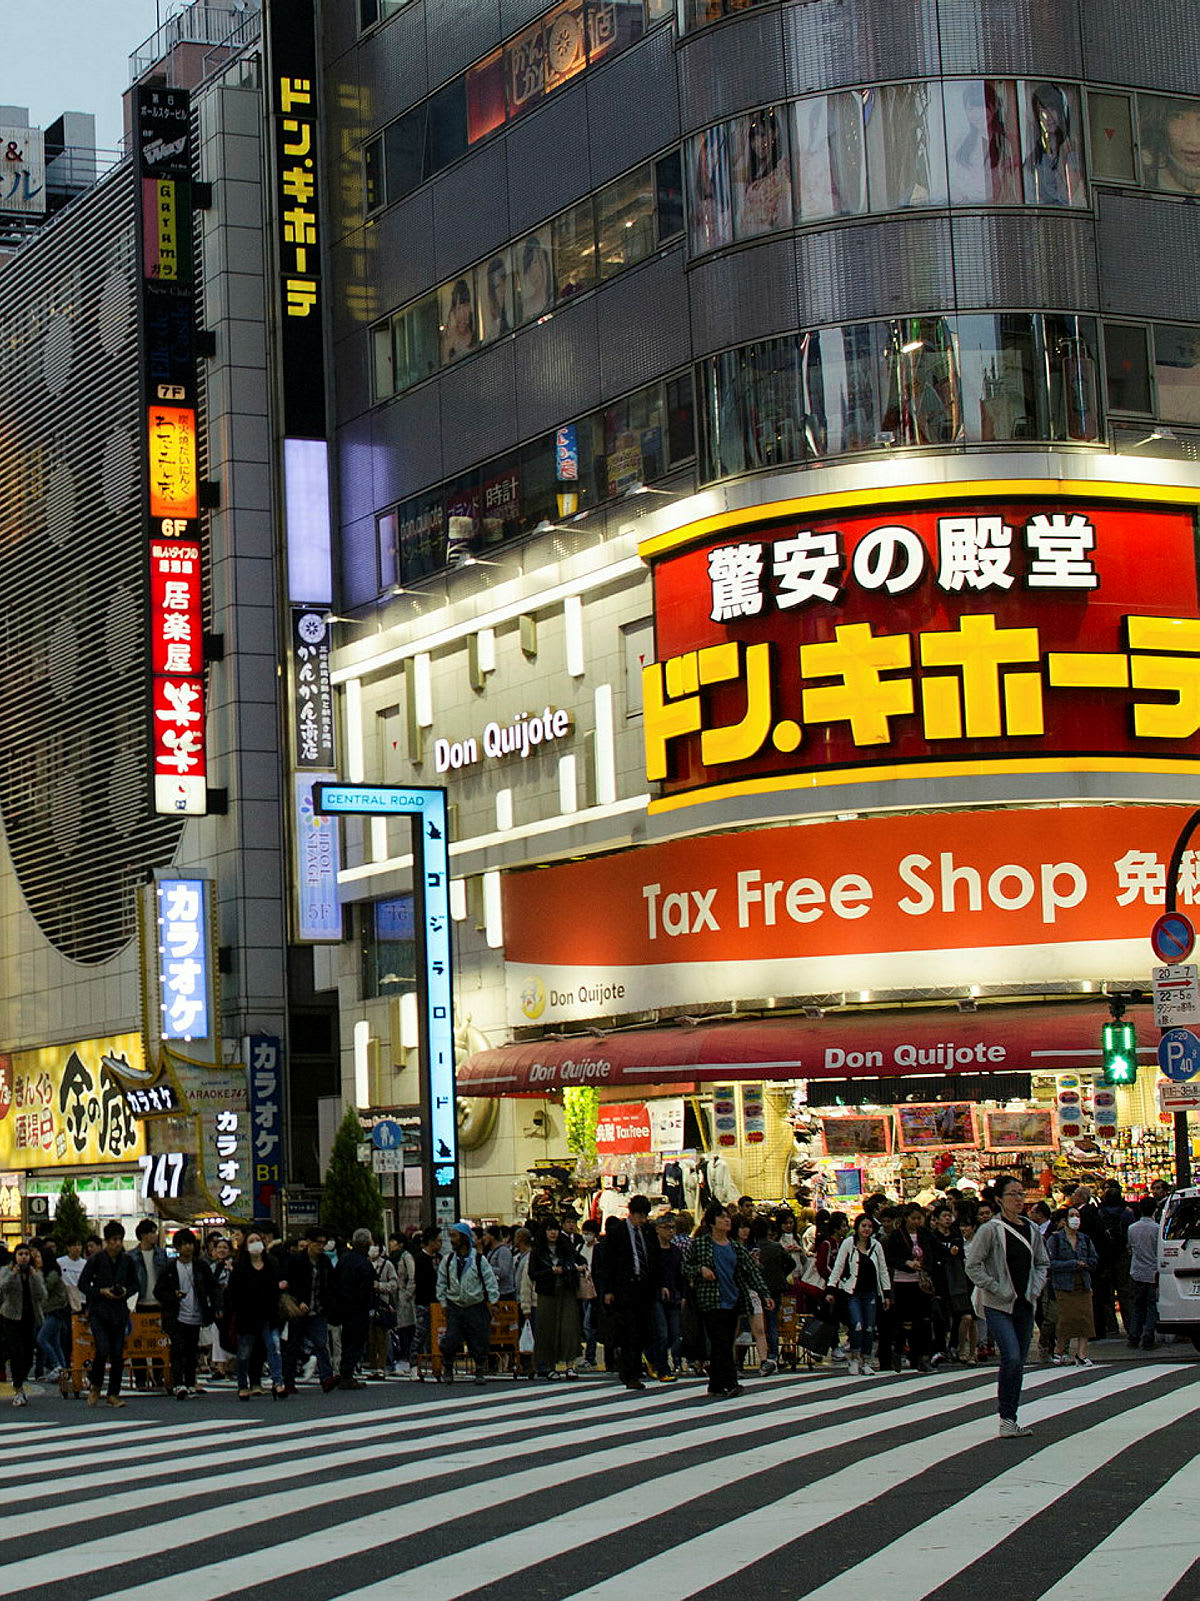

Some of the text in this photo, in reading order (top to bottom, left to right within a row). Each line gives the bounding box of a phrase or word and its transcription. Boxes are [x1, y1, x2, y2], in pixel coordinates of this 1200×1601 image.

[161, 387, 183, 398] 7F
[486, 476, 519, 508] 時計
[162, 519, 188, 537] 6F
[708, 514, 1098, 623] 驚安の殿堂
[162, 580, 193, 673] 居楽屋
[298, 646, 319, 760] かんかん商店
[156, 681, 203, 773] 笑笑
[435, 706, 570, 774] Don Quijote
[327, 793, 425, 807] CENTRAL ROAD
[308, 903, 331, 920] 5F
[642, 883, 721, 940] Tax
[737, 868, 874, 929] Free
[897, 851, 1088, 924] Shop
[166, 884, 203, 1033] カラオケ
[427, 872, 451, 1110] ゴジラロード
[550, 982, 626, 1007] Don Quijote
[529, 1059, 612, 1083] Don Quijote
[824, 1043, 1007, 1069] Don Quijote
[1167, 1041, 1193, 1074] P 40
[126, 1085, 173, 1113] カラオケ
[254, 1043, 279, 1158] カラオケ
[138, 1152, 184, 1199] 747
[216, 1111, 242, 1208] カラオケ
[256, 1165, 279, 1182] B1
